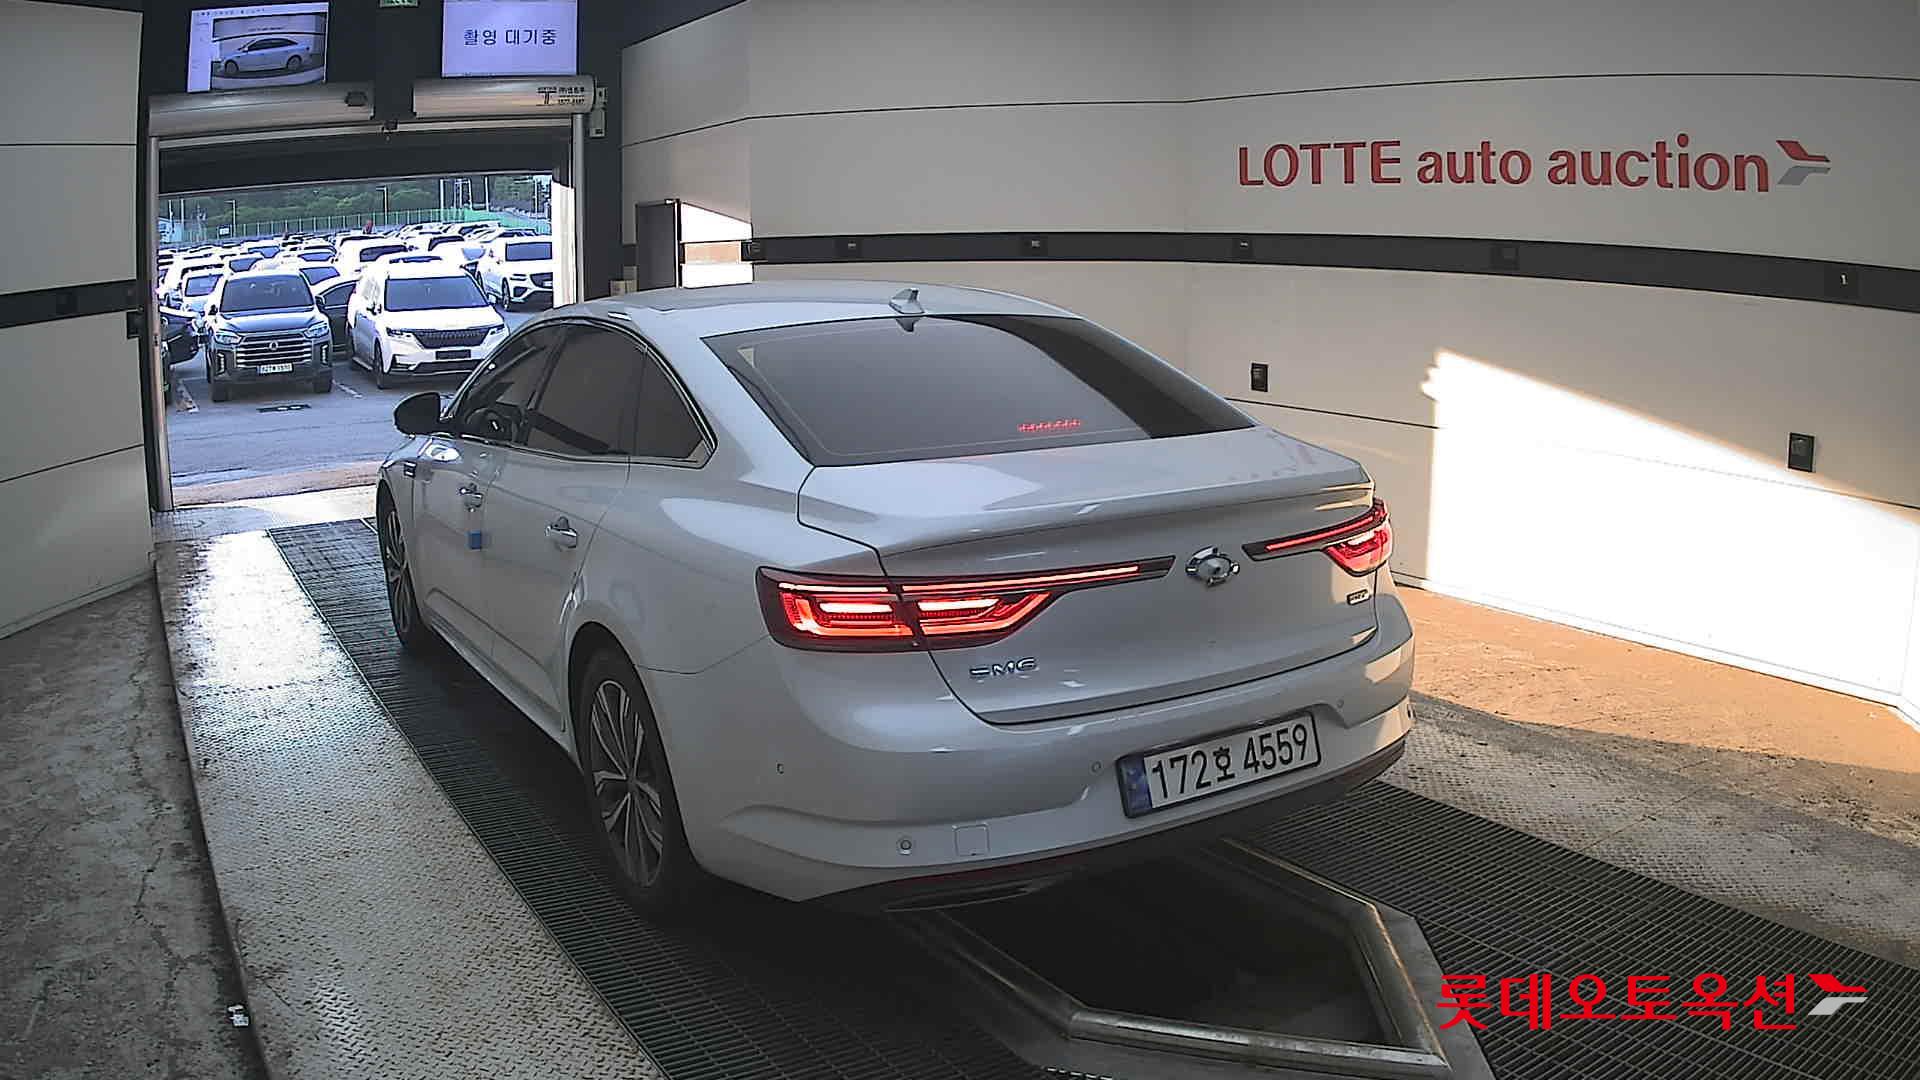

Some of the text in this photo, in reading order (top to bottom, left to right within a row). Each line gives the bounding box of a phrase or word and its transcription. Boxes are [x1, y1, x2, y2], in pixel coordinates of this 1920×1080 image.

[463, 29, 558, 46] 촬영 대기중
[1239, 133, 1770, 193] LOTTE auto auction
[1151, 746, 1236, 799] 172호
[1243, 723, 1308, 773] 4559
